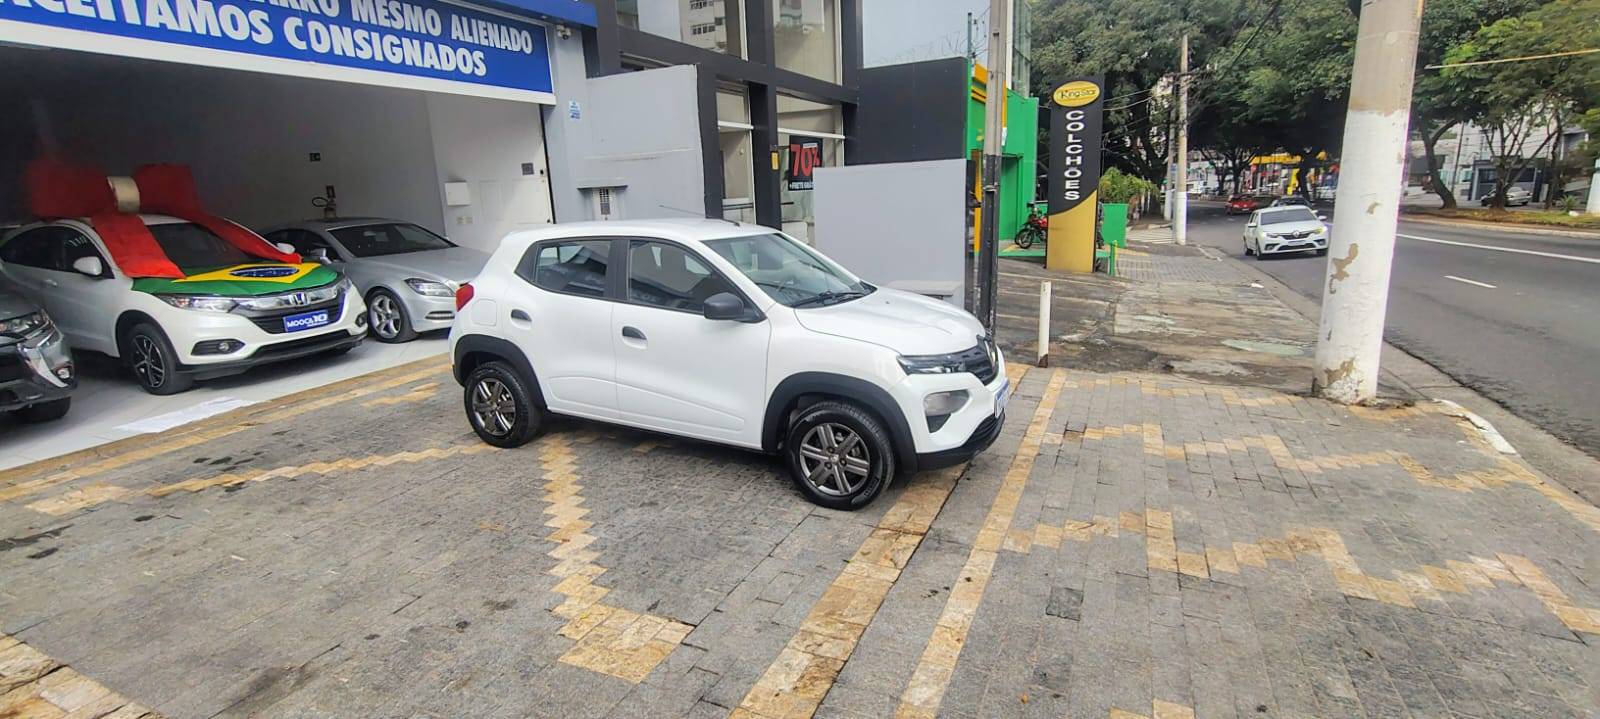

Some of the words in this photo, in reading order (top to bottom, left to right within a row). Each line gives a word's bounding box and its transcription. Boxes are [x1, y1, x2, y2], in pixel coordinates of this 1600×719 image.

[283, 17, 487, 77] CONSIGNADOS
[351, 0, 442, 37] MESMO
[451, 14, 533, 55] ALIENADO
[790, 144, 820, 176] 70%
[1064, 110, 1085, 201] COLCHÕES
